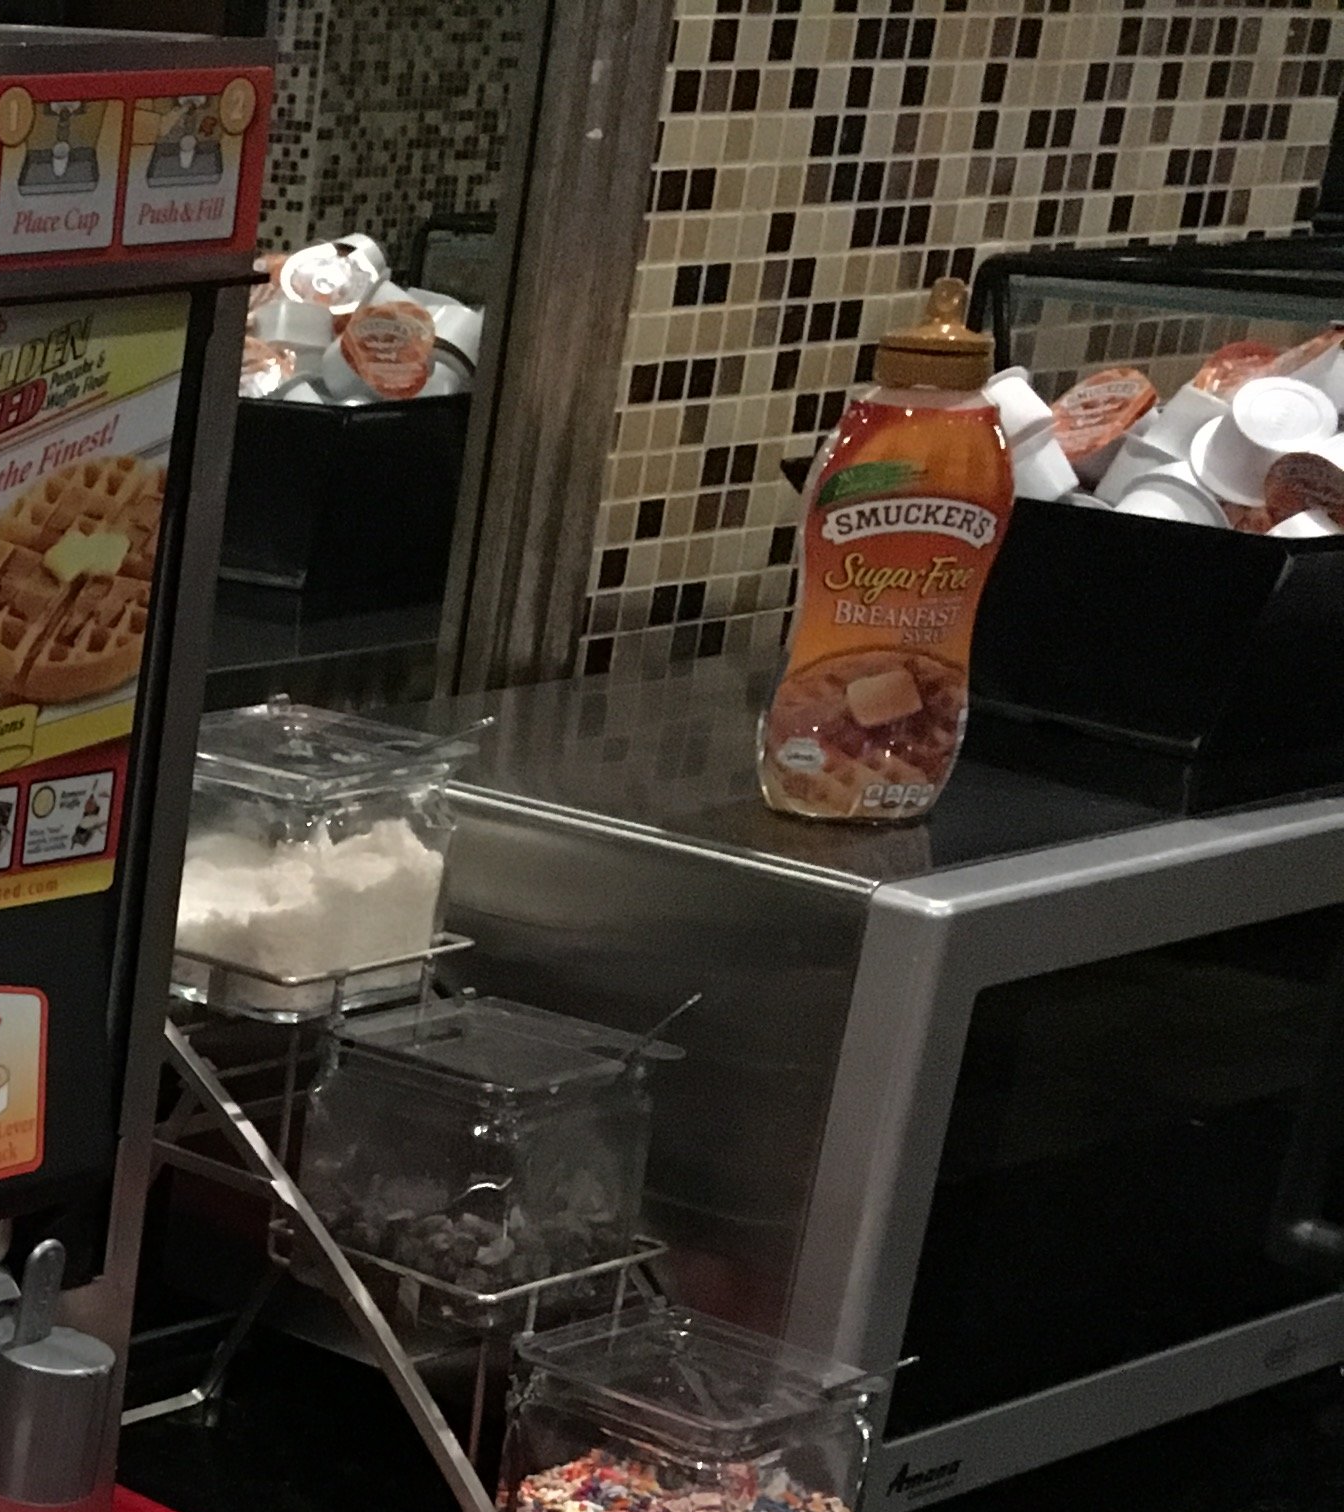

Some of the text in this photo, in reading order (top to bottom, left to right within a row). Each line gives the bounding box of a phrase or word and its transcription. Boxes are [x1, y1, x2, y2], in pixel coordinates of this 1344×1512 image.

[13, 207, 100, 236] Place Cup
[36, 414, 119, 477] Finest!
[836, 503, 991, 539] SMUCKER'S
[825, 552, 975, 604] Sugar Free
[834, 599, 963, 628] BREAKFAST
